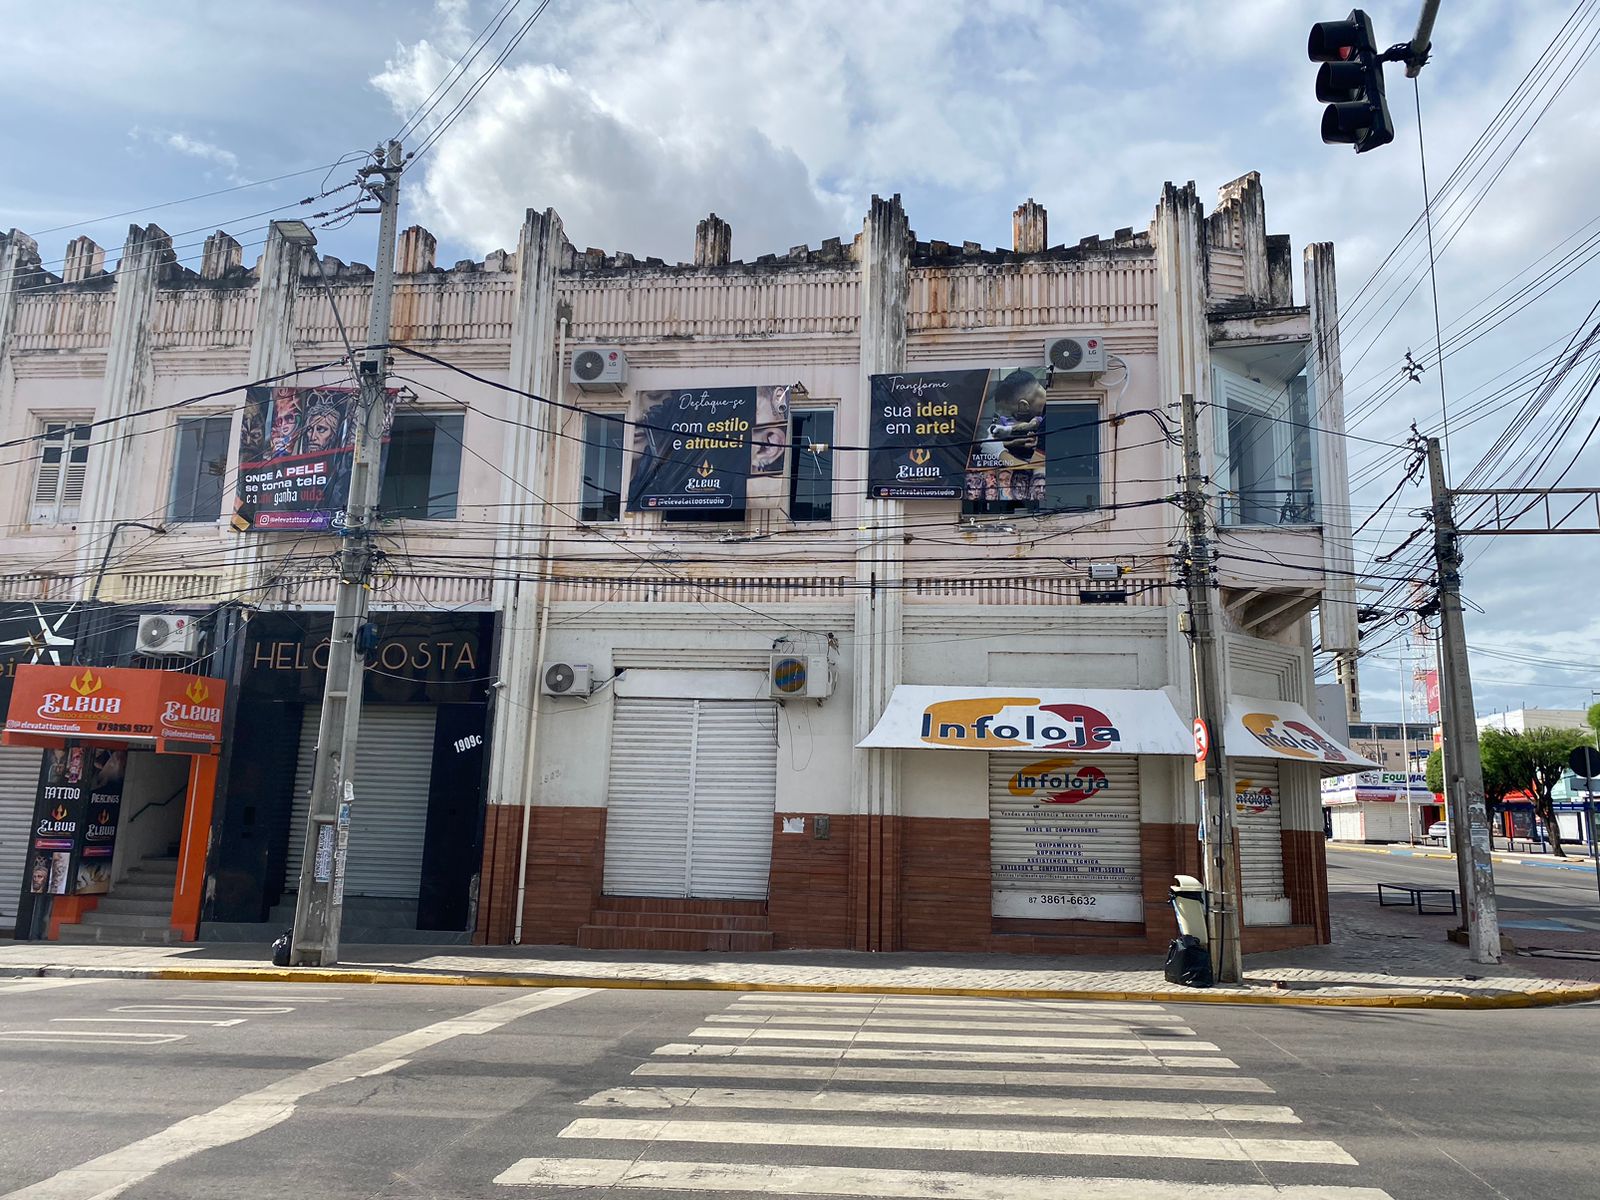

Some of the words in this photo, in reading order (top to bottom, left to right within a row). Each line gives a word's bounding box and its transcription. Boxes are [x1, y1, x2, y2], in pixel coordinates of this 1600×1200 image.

[888, 376, 949, 396] Transforme
[678, 391, 745, 414] Destaque-se
[883, 406, 912, 417] sua
[916, 402, 958, 418] ideia
[671, 422, 703, 433] com
[706, 418, 749, 432] estilo
[885, 423, 911, 435] em
[915, 420, 956, 435] arte!
[672, 440, 682, 450] e
[685, 434, 743, 449] atitude!
[245, 472, 273, 483] ONDE
[275, 469, 283, 479] A
[286, 462, 325, 476] PELE
[245, 484, 259, 492] se
[261, 479, 293, 491] torna
[296, 474, 327, 487] tela
[273, 488, 298, 506] ganha
[920, 713, 1121, 748] Infoloja
[1016, 772, 1109, 794] Infoloja
[1028, 896, 1038, 904] 87
[1040, 895, 1097, 906] 3861-6632
